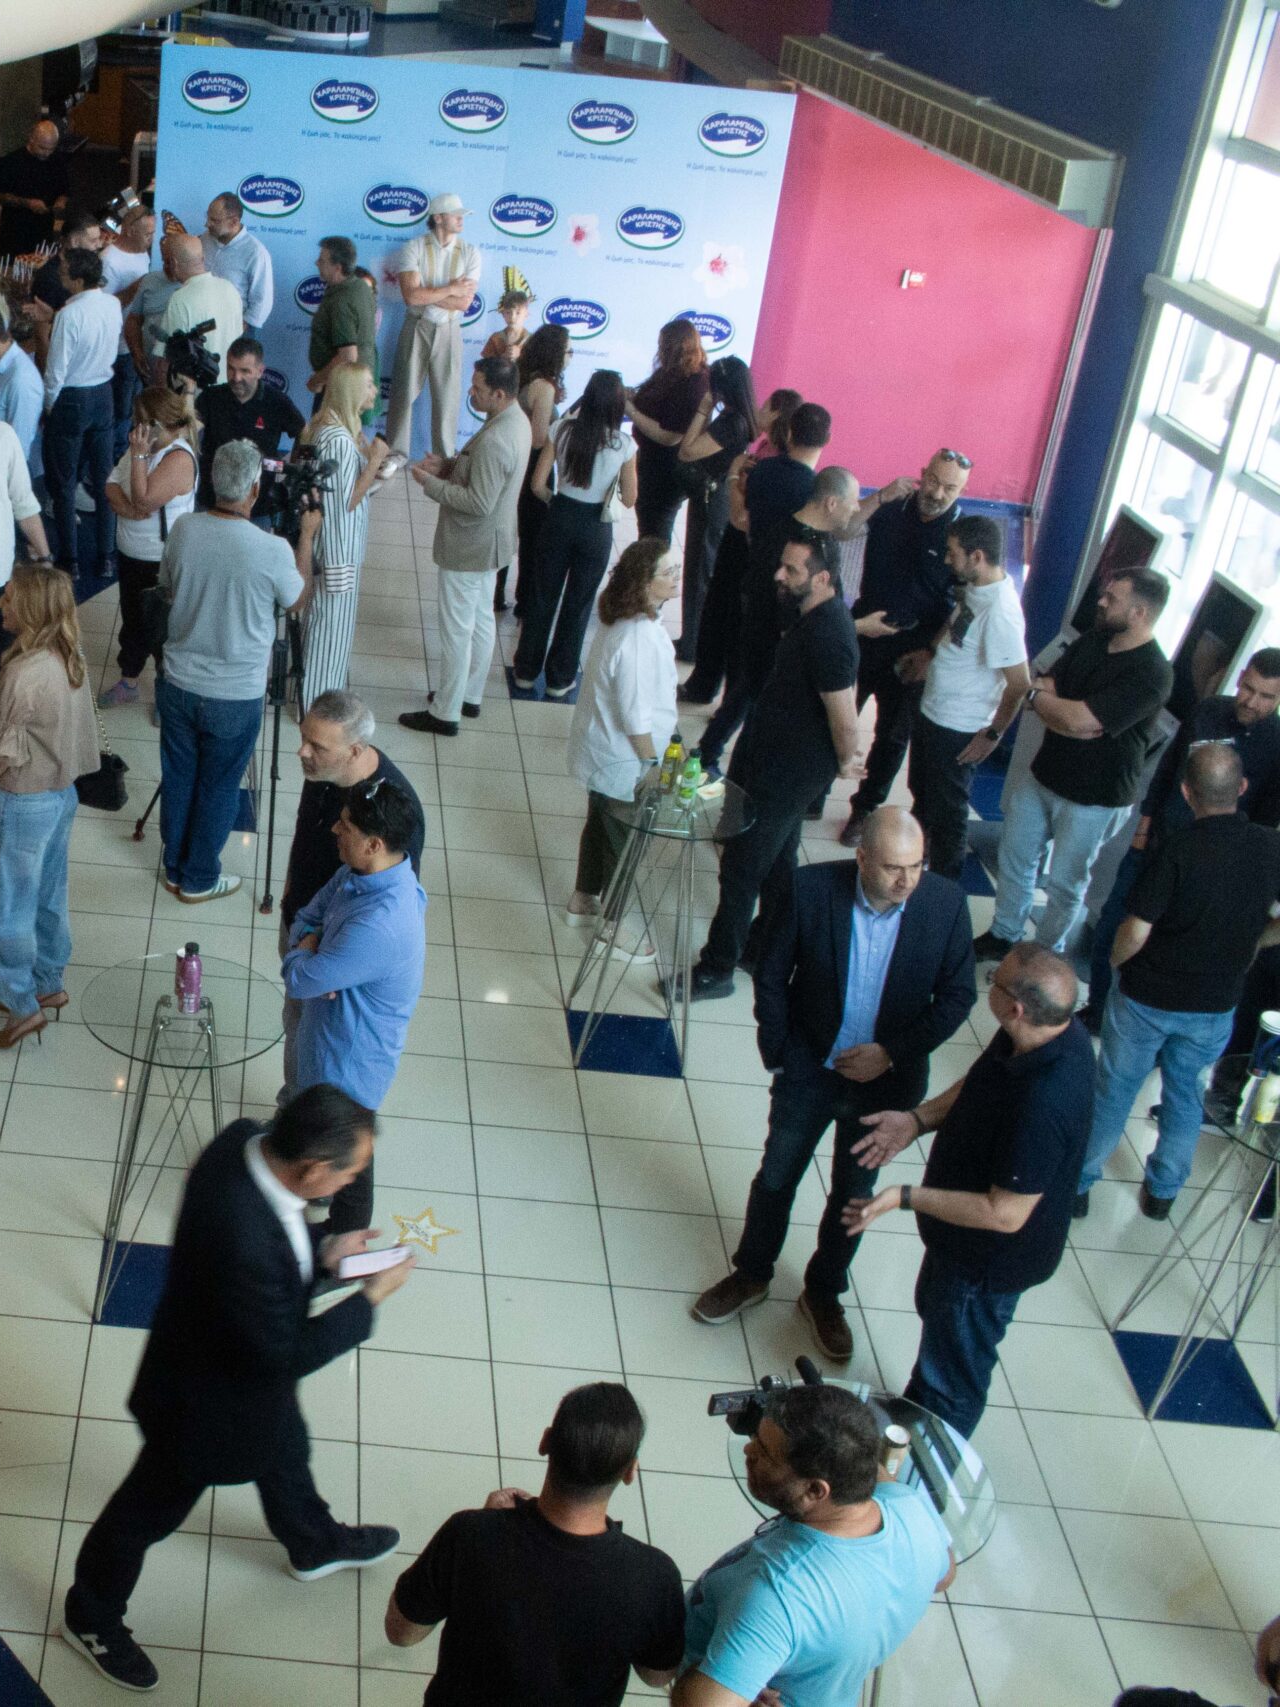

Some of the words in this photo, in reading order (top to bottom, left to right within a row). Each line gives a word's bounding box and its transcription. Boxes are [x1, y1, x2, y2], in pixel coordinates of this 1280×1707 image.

[188, 77, 246, 93] ΧΑΡΑΛΑΜΠΙΔΗΣ
[201, 84, 231, 94] ΚΡΙΣΤΗΣ
[316, 86, 374, 102] ΧΑΡΑΛΑΜΠΙΔΗΣ
[329, 93, 359, 103] ΚΡΙΣΤΗΣ
[445, 96, 503, 112] ΧΑΡΑΛΑΜΠΙΔΗΣ
[458, 103, 488, 113] ΚΡΙΣΤΗΣ
[574, 107, 633, 124] ΧΑΡΑΛΑΜΠΙΔΗΣ
[587, 115, 618, 124] ΚΡΙΣΤΗΣ
[704, 120, 764, 137] ΧΑΡΑΛΑΜΠΙΔΗΣ
[717, 127, 748, 137] ΚΡΙΣΤΗΣ
[243, 181, 300, 197] ΧΑΡΑΛΑΜΠΙΔΗΣ
[256, 188, 285, 198] ΚΡΙΣΤΗΣ
[369, 191, 426, 207] ΧΑΡΑΛΑΜΠΙΔΗΣ
[382, 198, 411, 207] ΚΡΙΣΤΗΣ
[495, 201, 553, 217] ΧΑΡΑΛΑΜΠΙΔΗΣ
[508, 208, 538, 218] ΚΡΙΣΤΗΣ
[622, 213, 680, 230] ΧΑΡΑΛΑΜΠΙΔΗΣ
[635, 221, 665, 230] ΚΡΙΣΤΗΣ
[548, 304, 605, 320] ΧΑΡΑΛΑΜΠΙΔΗΣ
[561, 312, 591, 321] ΚΡΙΣΤΗΣ
[688, 317, 730, 334] ΑΛΑΜΠΙΔΗΣ
